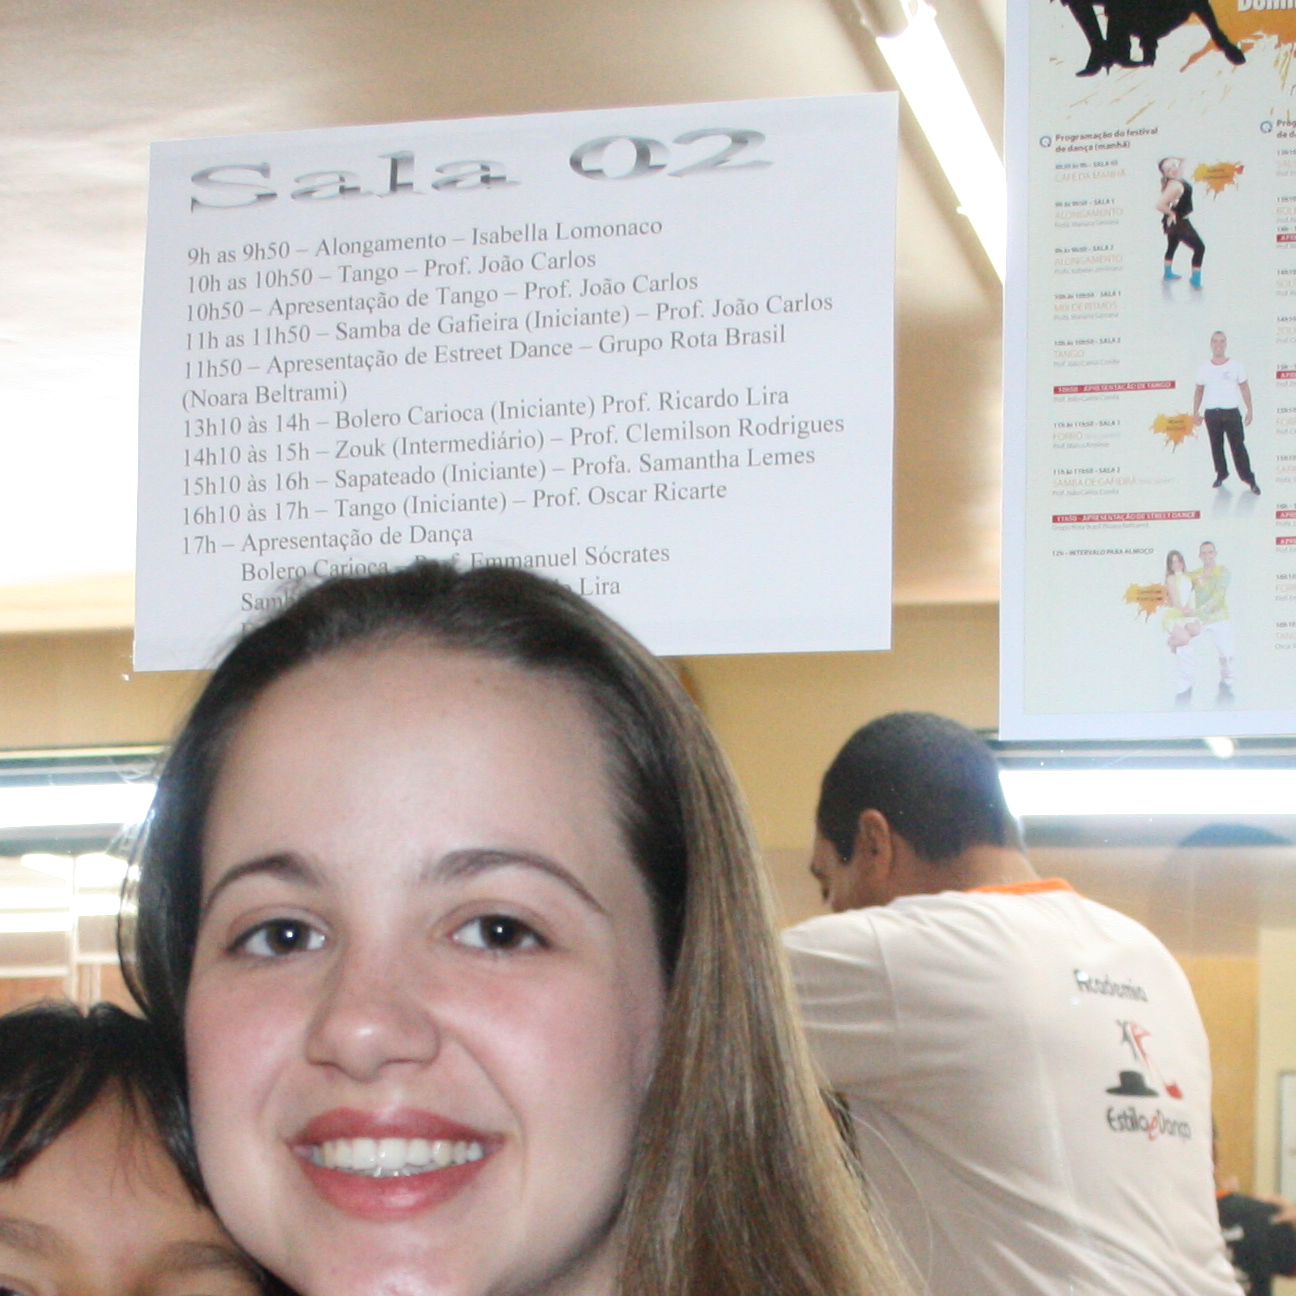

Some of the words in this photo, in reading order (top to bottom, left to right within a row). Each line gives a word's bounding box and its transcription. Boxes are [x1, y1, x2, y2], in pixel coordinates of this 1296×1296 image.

[190, 150, 520, 213] Sala
[570, 128, 775, 181] 02
[187, 246, 211, 266] 9h
[216, 249, 237, 264] as
[242, 240, 291, 262] 9h50
[314, 233, 447, 259] Alongamento
[471, 222, 549, 246] Isabella
[555, 220, 663, 241] Lomonaco
[188, 273, 222, 294] 10h
[226, 277, 247, 292] as
[256, 267, 314, 289] 10h50
[337, 264, 399, 287] Tango
[423, 255, 472, 278] Prof.
[477, 254, 525, 275] João
[530, 248, 597, 271] Carlos
[186, 330, 219, 351] 11h
[224, 334, 245, 349] as
[253, 324, 311, 346] 11h50
[335, 318, 402, 341] Samba
[407, 316, 431, 337] de
[437, 309, 520, 335] Gafieira
[523, 304, 630, 334] (Iniciante)
[655, 298, 705, 322] Prof.
[711, 297, 760, 318] João
[765, 292, 833, 315] Carlos
[187, 300, 245, 322] 10h50
[267, 291, 400, 321] Apresentação
[405, 287, 430, 308] de
[434, 285, 499, 309] Tango
[524, 278, 573, 301] Prof.
[579, 277, 626, 298] João
[632, 271, 699, 294] Carlos
[185, 357, 242, 380] 11h50
[266, 349, 399, 379] Apresentação
[404, 345, 428, 366] de
[433, 344, 503, 364] Estreet
[509, 340, 574, 360] Dance
[598, 334, 664, 357] Grupo
[669, 330, 718, 350] Rota
[724, 323, 785, 347] Brasil
[181, 388, 249, 414] (Noara
[254, 380, 348, 405] Beltrami)
[184, 416, 242, 438] 13h10
[247, 414, 268, 435] às
[276, 412, 311, 433] 14h
[334, 407, 402, 430] Bolero
[407, 403, 485, 426] Carioca
[490, 395, 596, 426] (Iniciante)
[601, 391, 651, 415] Prof.
[657, 387, 740, 412] Ricardo
[745, 384, 790, 407] Lira
[184, 445, 242, 468] 14h10
[247, 444, 268, 464] às
[276, 441, 310, 462] 15h
[334, 437, 387, 460] Zouk
[392, 428, 545, 461] (Intermediário)
[569, 423, 619, 447] Prof.
[625, 419, 732, 444] Clemilson
[738, 414, 845, 440] Rodrigues
[183, 474, 242, 497] 15h10
[246, 473, 267, 493] às
[275, 470, 310, 492] 16h
[334, 464, 436, 493] Sapateado
[441, 458, 547, 489] (Iniciante)
[571, 453, 632, 477] Profa.
[639, 448, 740, 473] Samantha
[746, 447, 816, 468] Lemes
[183, 503, 241, 526] 16h10
[246, 502, 267, 523] às
[275, 499, 309, 521] 17h
[333, 498, 397, 522] Tango
[402, 491, 507, 519] (Iniciante)
[532, 486, 581, 509] Prof.
[587, 485, 648, 506] Oscar
[653, 481, 728, 503] Ricarte
[183, 534, 217, 555] 17h
[241, 528, 374, 557] Apresentação
[379, 525, 403, 546] de
[409, 524, 474, 547] Dança
[241, 563, 307, 582] Bolero
[584, 545, 671, 566] Sócrates
